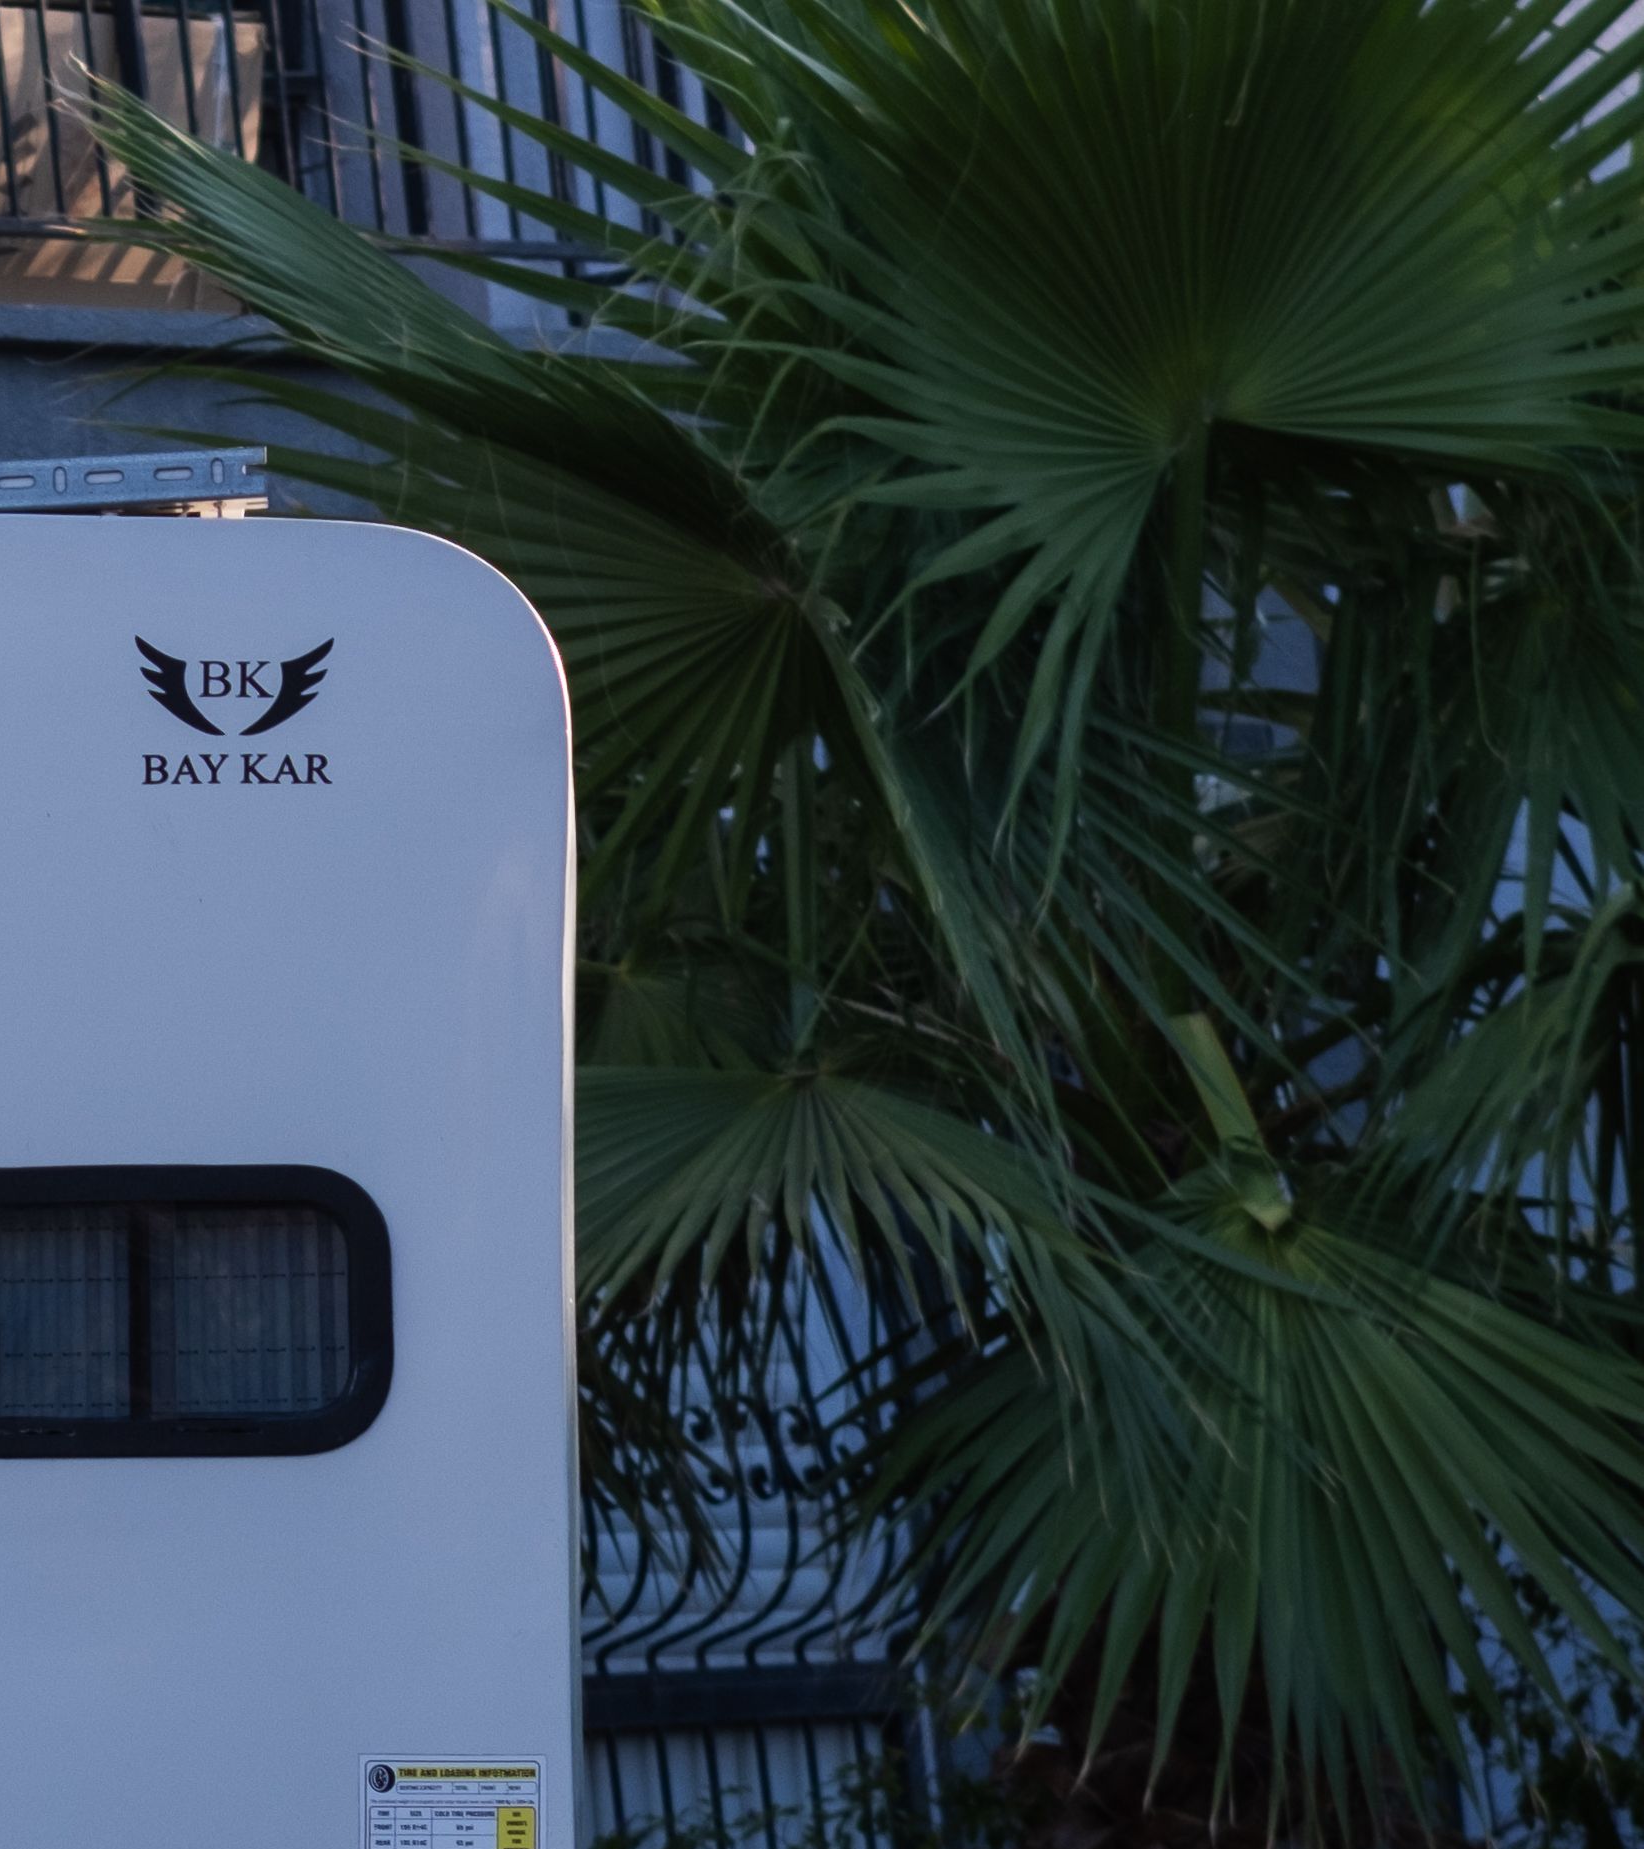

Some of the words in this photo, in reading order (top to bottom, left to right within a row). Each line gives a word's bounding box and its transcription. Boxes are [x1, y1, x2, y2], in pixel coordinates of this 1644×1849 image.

[199, 660, 275, 698] BK
[141, 753, 229, 785] BAY
[240, 753, 333, 785] KAR
[398, 1768, 417, 1777] TIRE
[420, 1768, 438, 1777] AND
